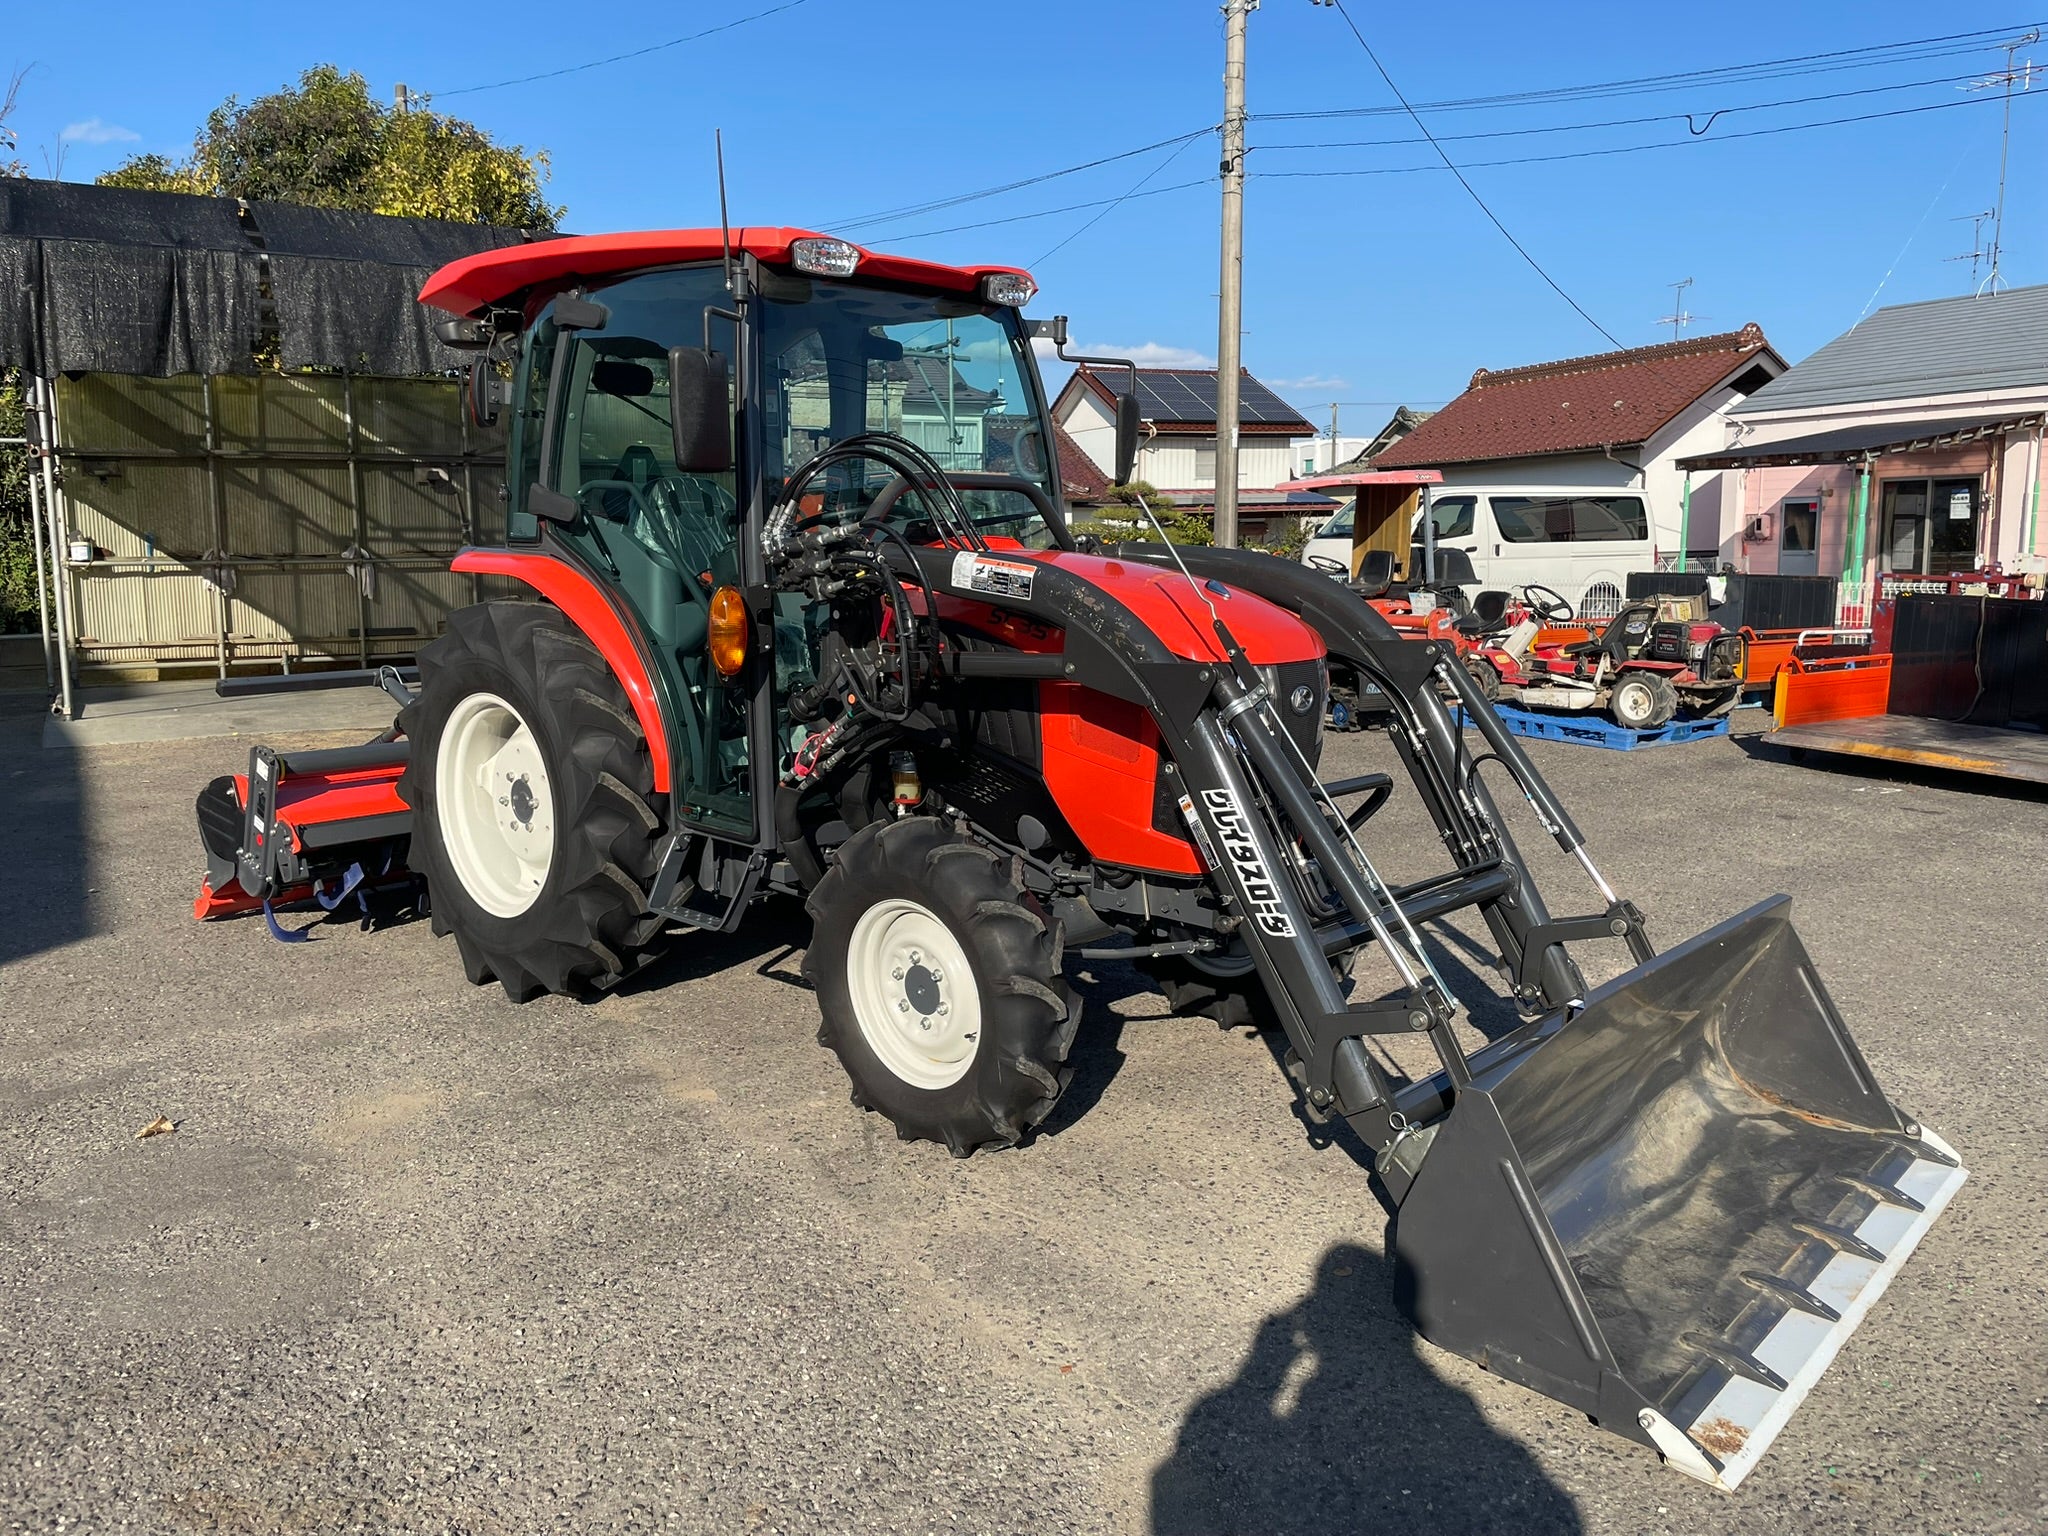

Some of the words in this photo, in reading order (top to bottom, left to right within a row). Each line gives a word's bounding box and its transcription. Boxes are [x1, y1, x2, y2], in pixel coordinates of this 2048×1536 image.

[1200, 788, 1298, 938] グレイタスローダ
